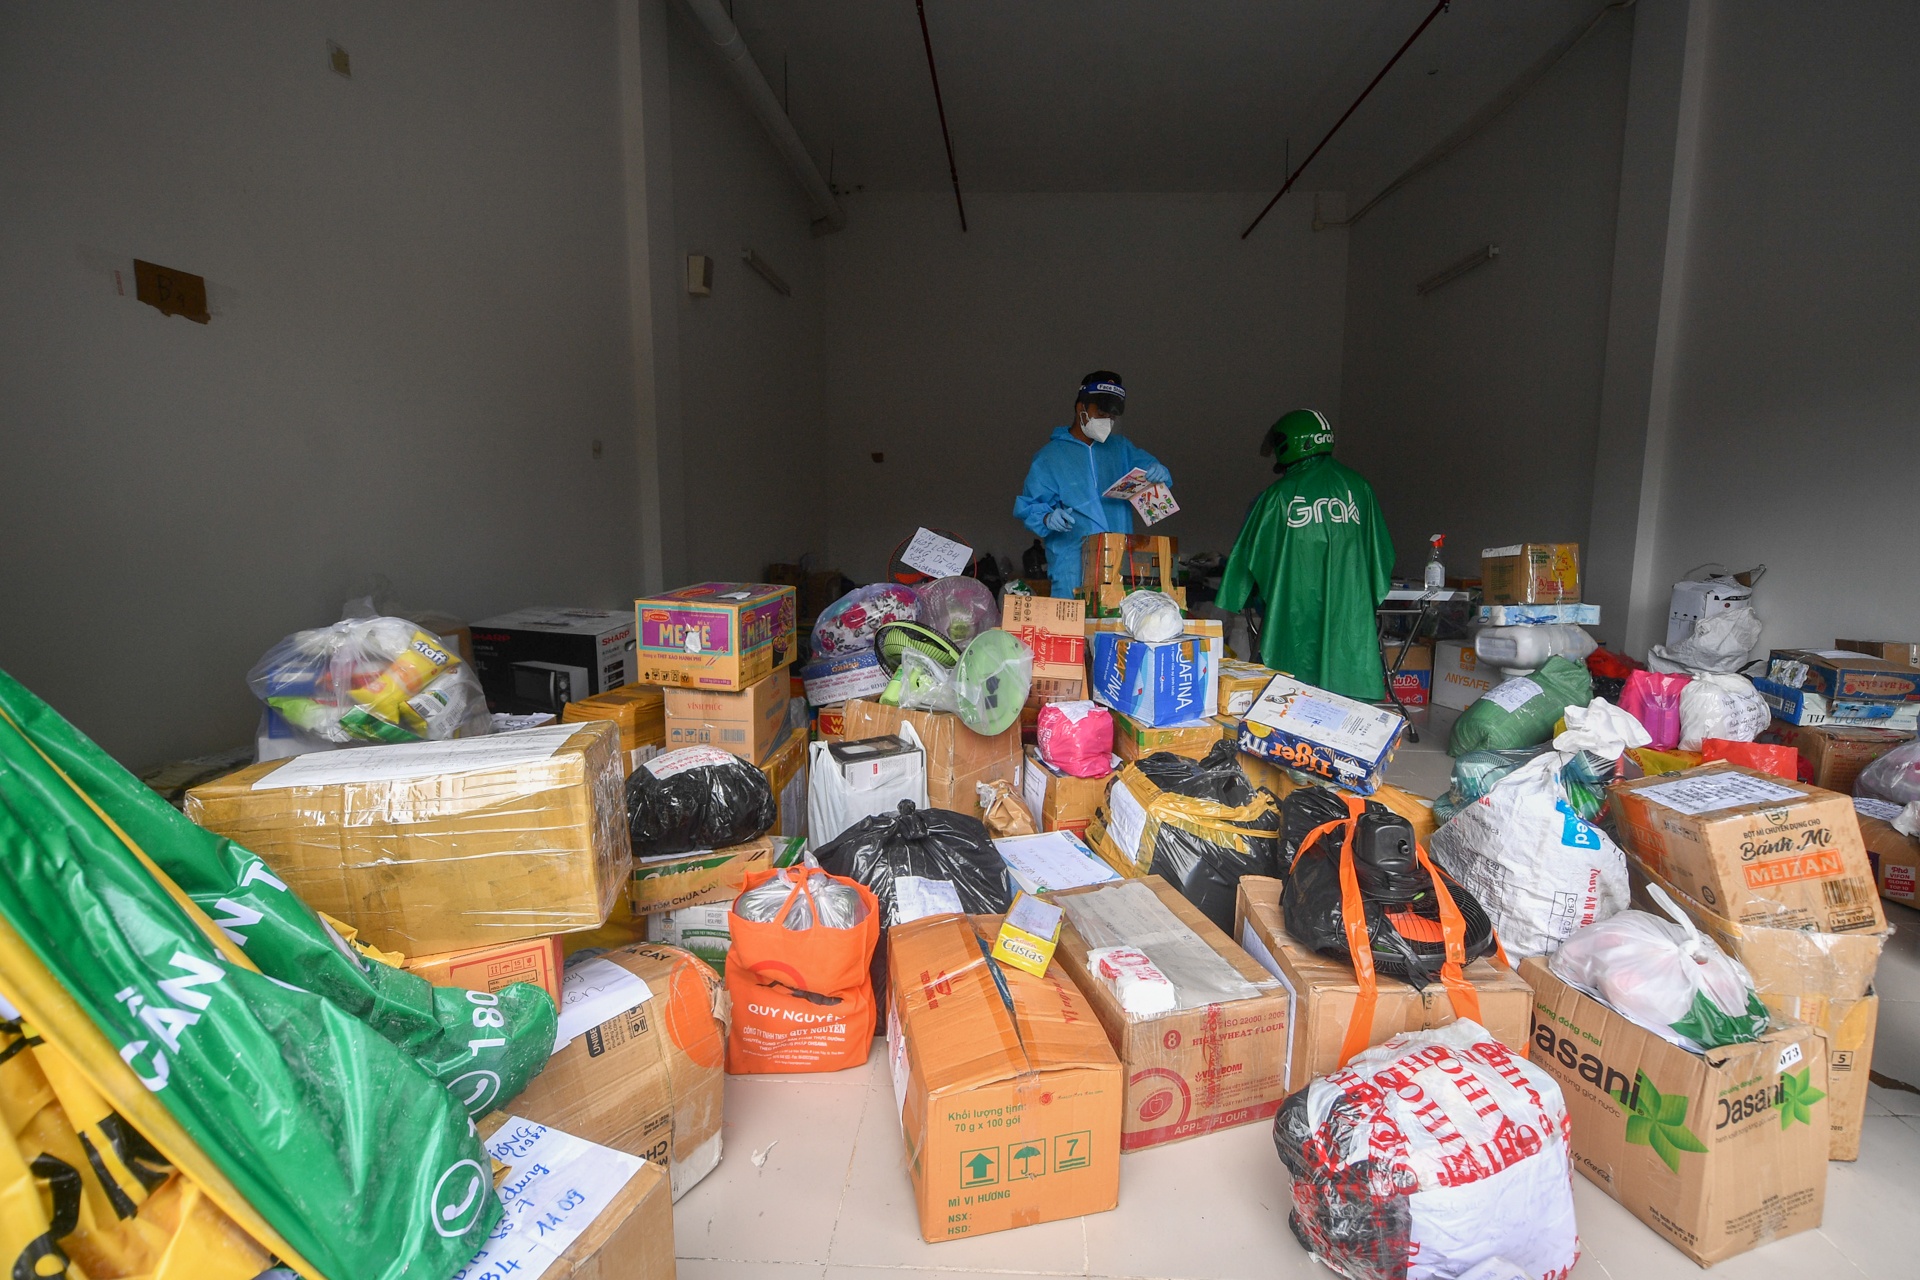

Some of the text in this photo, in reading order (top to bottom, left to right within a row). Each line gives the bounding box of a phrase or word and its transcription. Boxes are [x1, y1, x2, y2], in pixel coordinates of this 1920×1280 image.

[602, 630, 630, 646] SHARP
[1444, 672, 1490, 691] ANYSAFE
[1807, 714, 1826, 723] TH
[1269, 742, 1333, 778] Tiger
[1743, 818, 1820, 840] BỘT MÌ CHUYÊN DỤNG CHO
[1740, 828, 1832, 861] Bánh Mì
[1750, 854, 1838, 884] MEIZAN
[700, 880, 720, 894] CAY
[1836, 918, 1846, 926] kg
[639, 949, 671, 962] CAY
[1002, 938, 1046, 965] Custas
[512, 959, 522, 967] 15
[748, 1004, 780, 1018] QUY
[1224, 1018, 1238, 1028] ISO
[1240, 1014, 1262, 1025] 22000
[1268, 1011, 1285, 1020] 2005
[790, 1028, 809, 1037] QUY
[810, 1022, 846, 1034] NGUYÊN
[1219, 1028, 1253, 1041] WHEAT
[1254, 1022, 1284, 1034] FLOUR
[1168, 1032, 1178, 1048] 8
[1582, 1031, 1603, 1047] chai
[1838, 1054, 1847, 1064] 5
[1202, 1063, 1242, 1078] VIBOMI
[1598, 1097, 1621, 1118] nước
[1716, 1076, 1785, 1130] Dasani
[948, 1108, 972, 1122] Khối
[973, 1104, 1003, 1122] lượng
[954, 1122, 967, 1133] 70
[986, 1118, 1004, 1130] 100
[1005, 1114, 1021, 1128] gói
[1174, 1110, 1248, 1135] APPL FLOUR
[1066, 1138, 1080, 1157] 7
[948, 1189, 1011, 1208] MÌ VỊ HƯƠNG
[948, 1224, 972, 1236] HSD:
